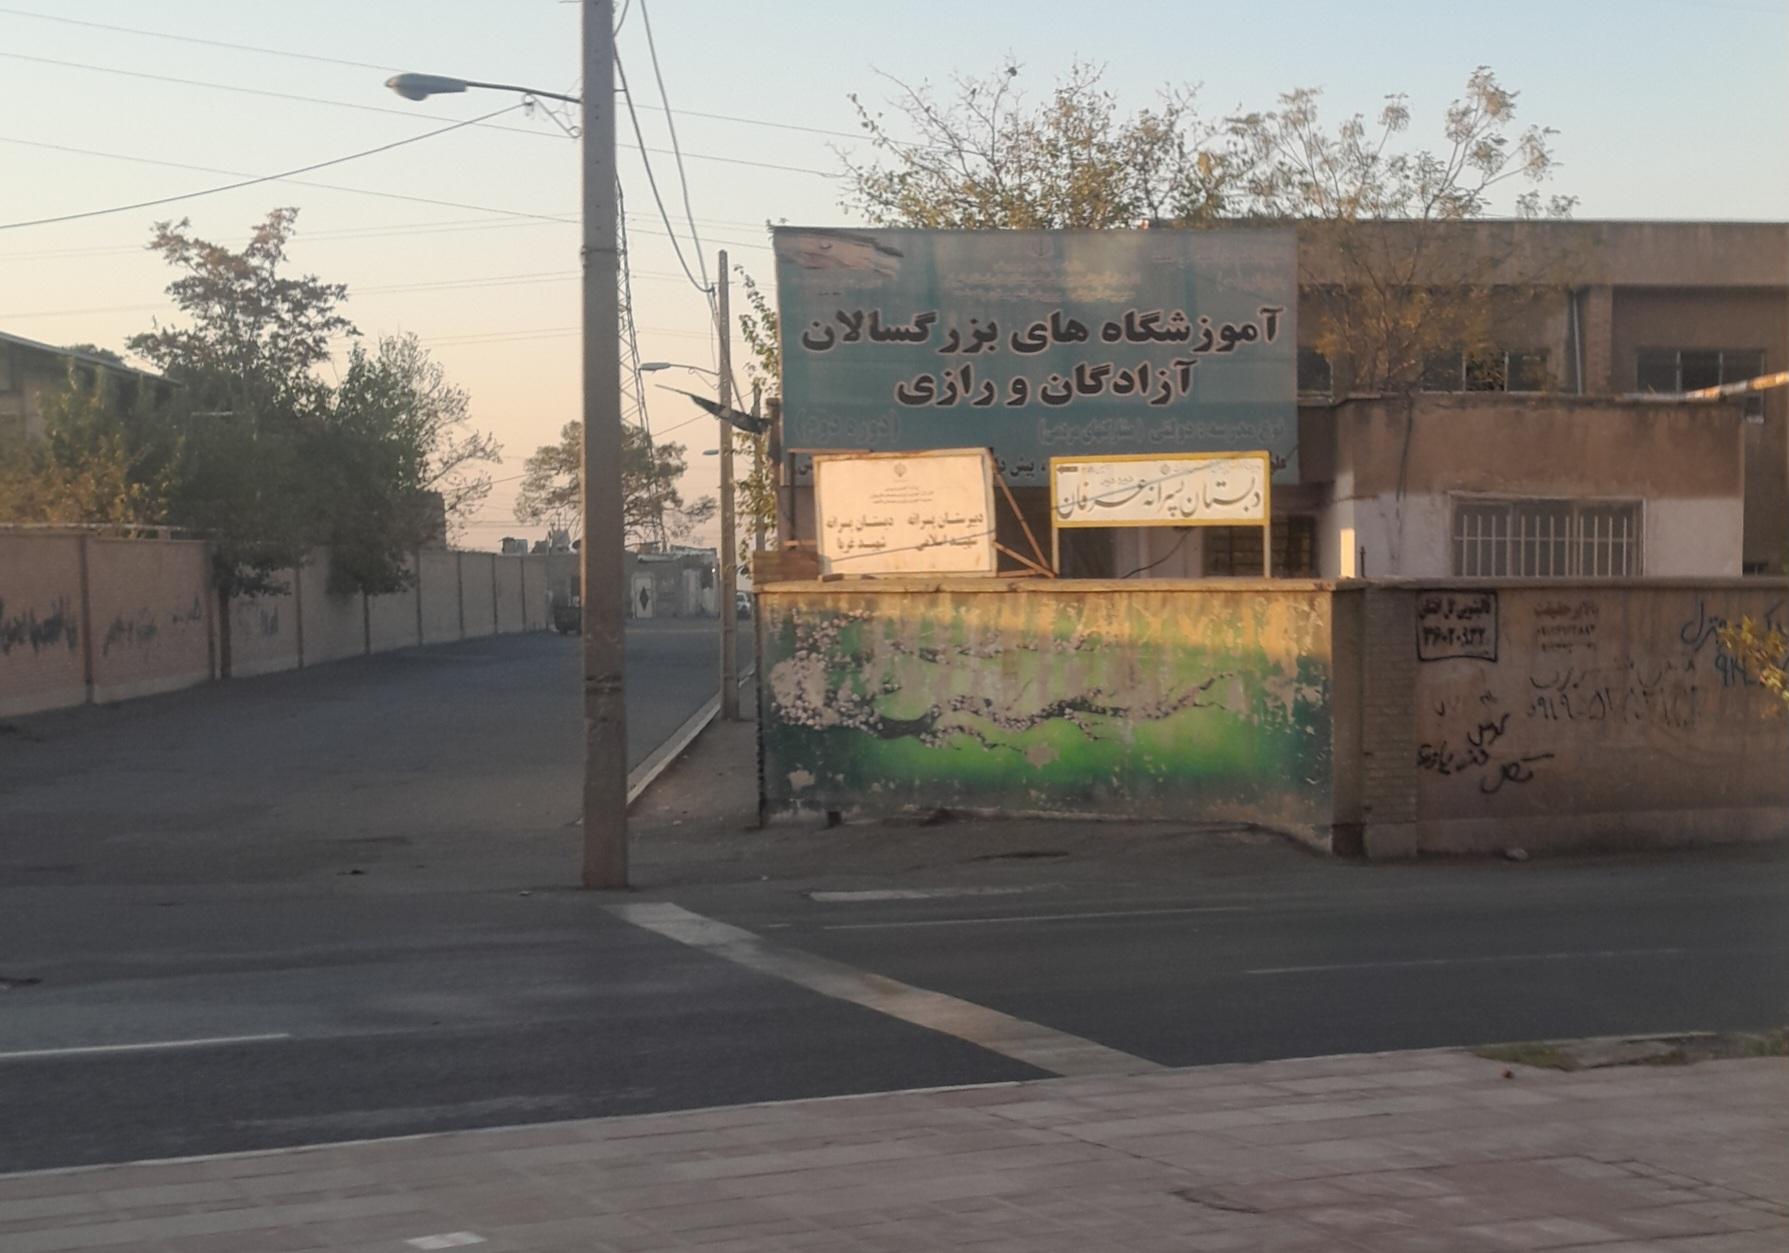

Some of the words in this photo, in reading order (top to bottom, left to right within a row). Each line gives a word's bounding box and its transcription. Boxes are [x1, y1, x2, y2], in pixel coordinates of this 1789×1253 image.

[1010, 309, 1090, 353] های
[1100, 305, 1284, 353] آموزشگاه
[898, 363, 995, 406] رازی
[1005, 376, 1028, 406] و
[1039, 358, 1198, 405] آزادگان
[1143, 480, 1184, 517] پسرانه
[1180, 476, 1261, 517] دبستان
